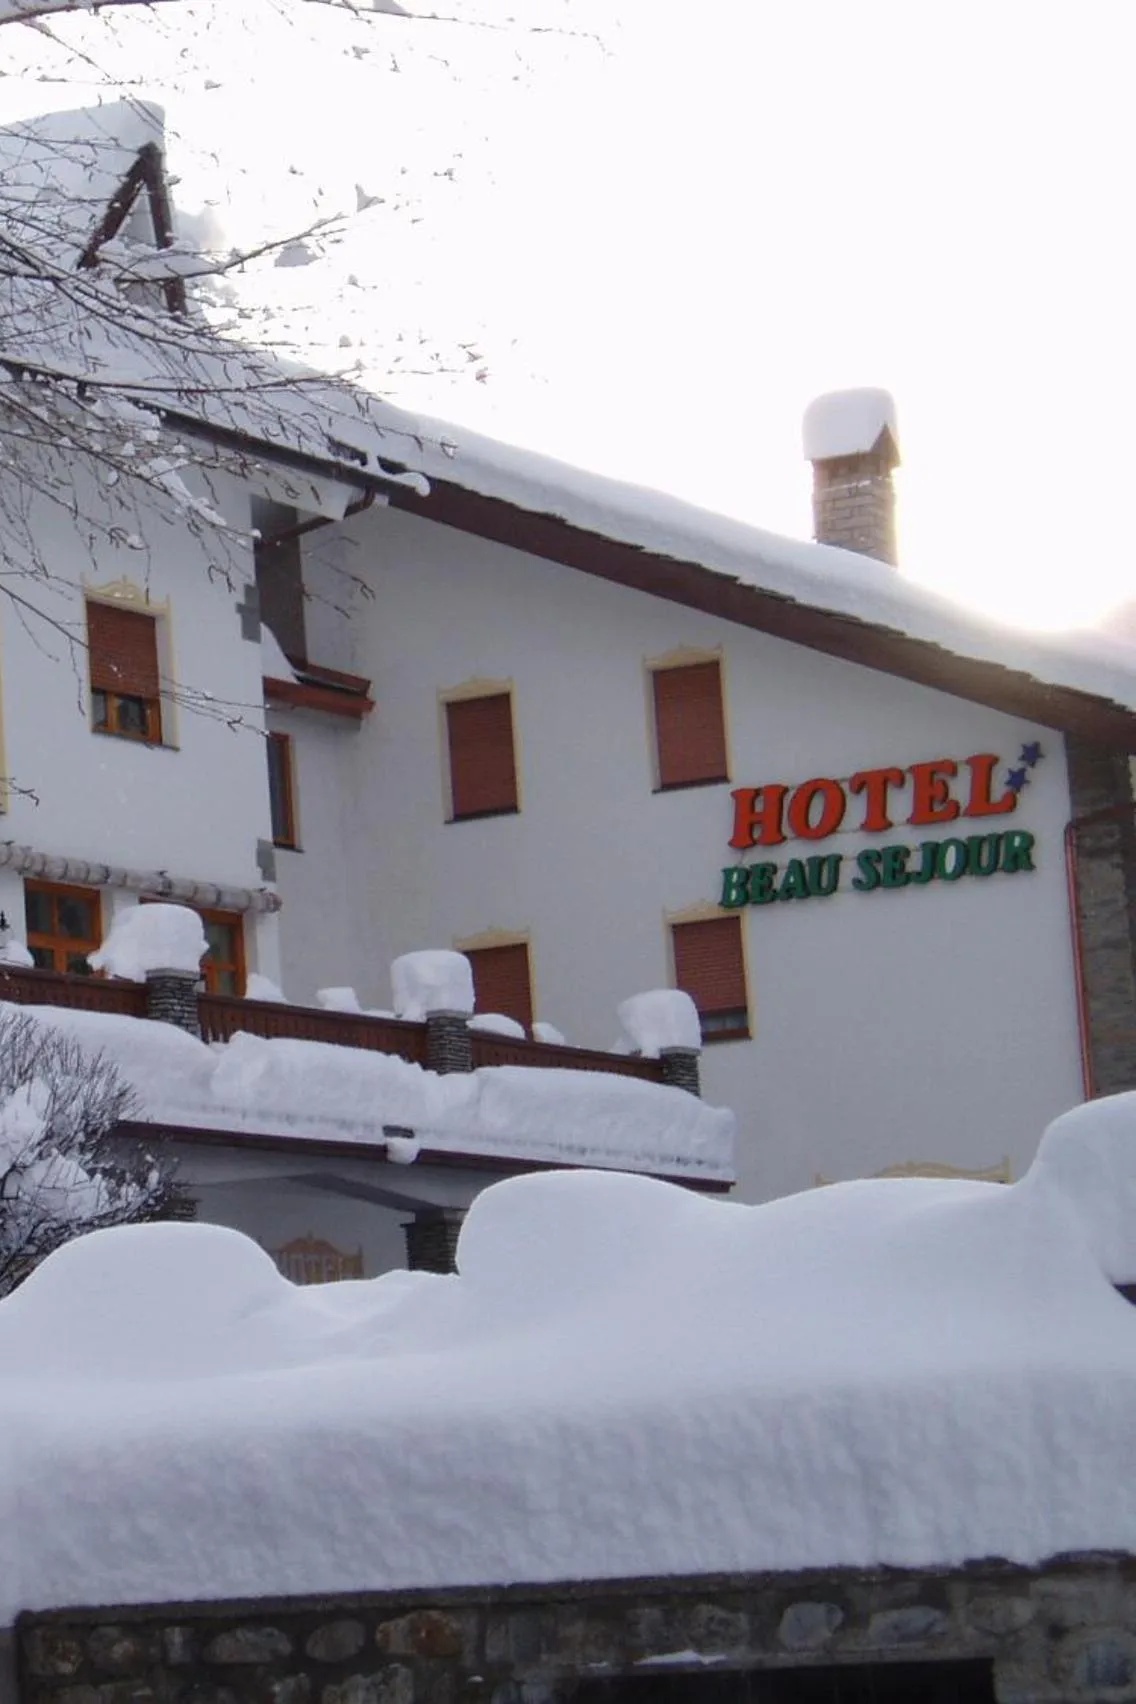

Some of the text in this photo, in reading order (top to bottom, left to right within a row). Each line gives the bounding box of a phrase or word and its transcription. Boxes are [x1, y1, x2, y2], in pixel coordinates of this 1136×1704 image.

[728, 753, 1018, 850] HOTEL
[718, 830, 1037, 910] BEAU SEJOUR
